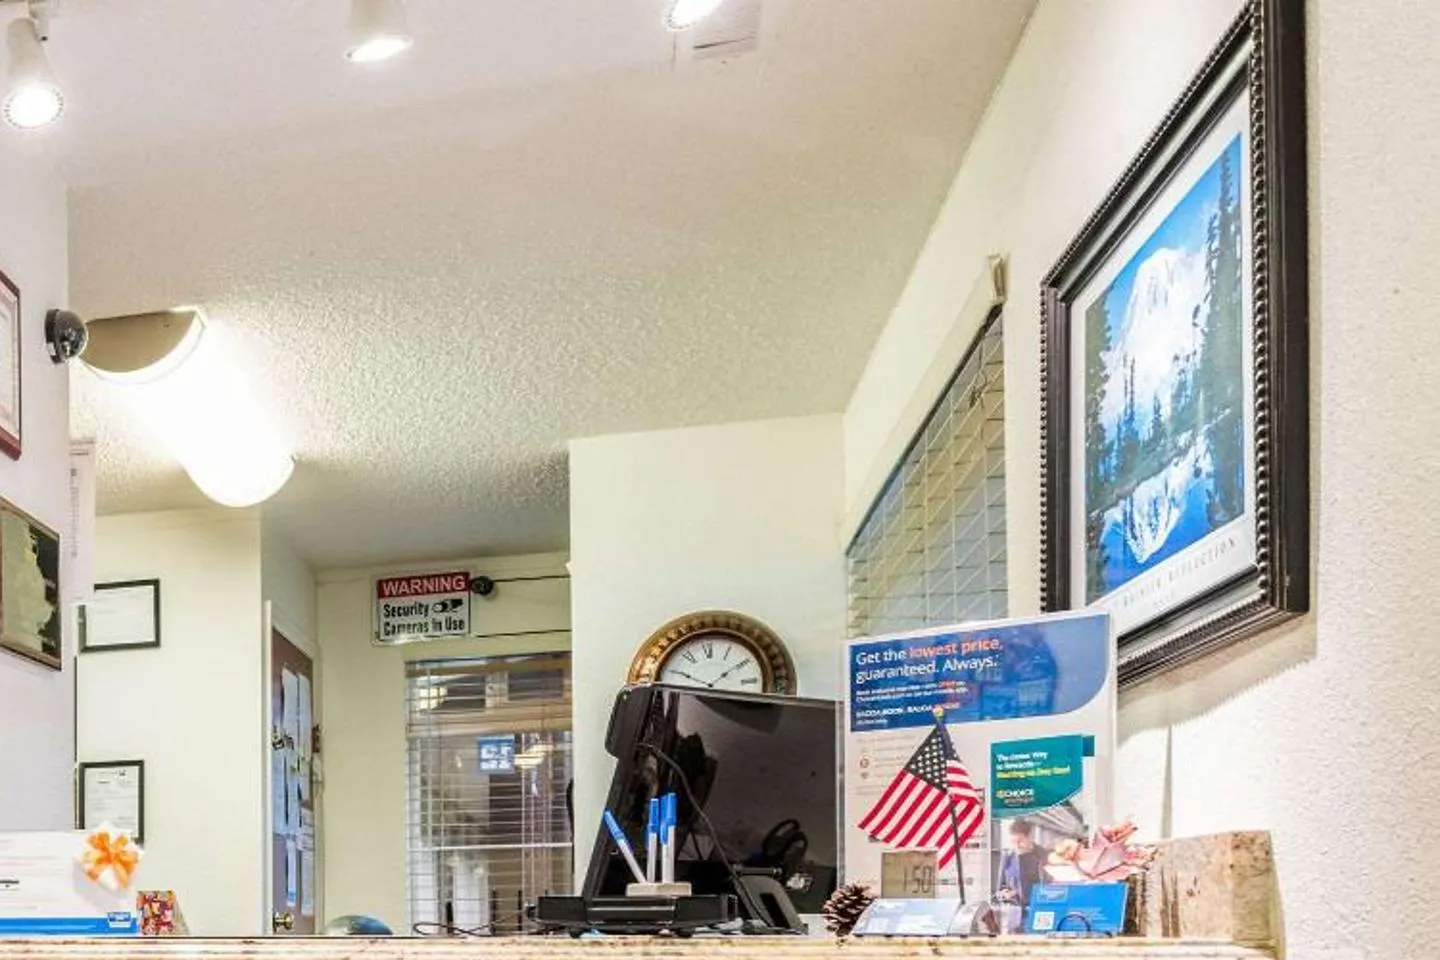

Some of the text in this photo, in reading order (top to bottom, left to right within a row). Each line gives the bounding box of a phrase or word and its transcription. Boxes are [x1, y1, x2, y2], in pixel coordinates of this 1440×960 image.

[382, 575, 466, 596] WARNING
[383, 602, 429, 618] Security
[383, 621, 429, 636] Cameras
[445, 616, 464, 631] Use
[856, 652, 881, 665] Get
[883, 649, 907, 661] the
[909, 642, 957, 658] lowest
[856, 661, 939, 684] guaranteed.
